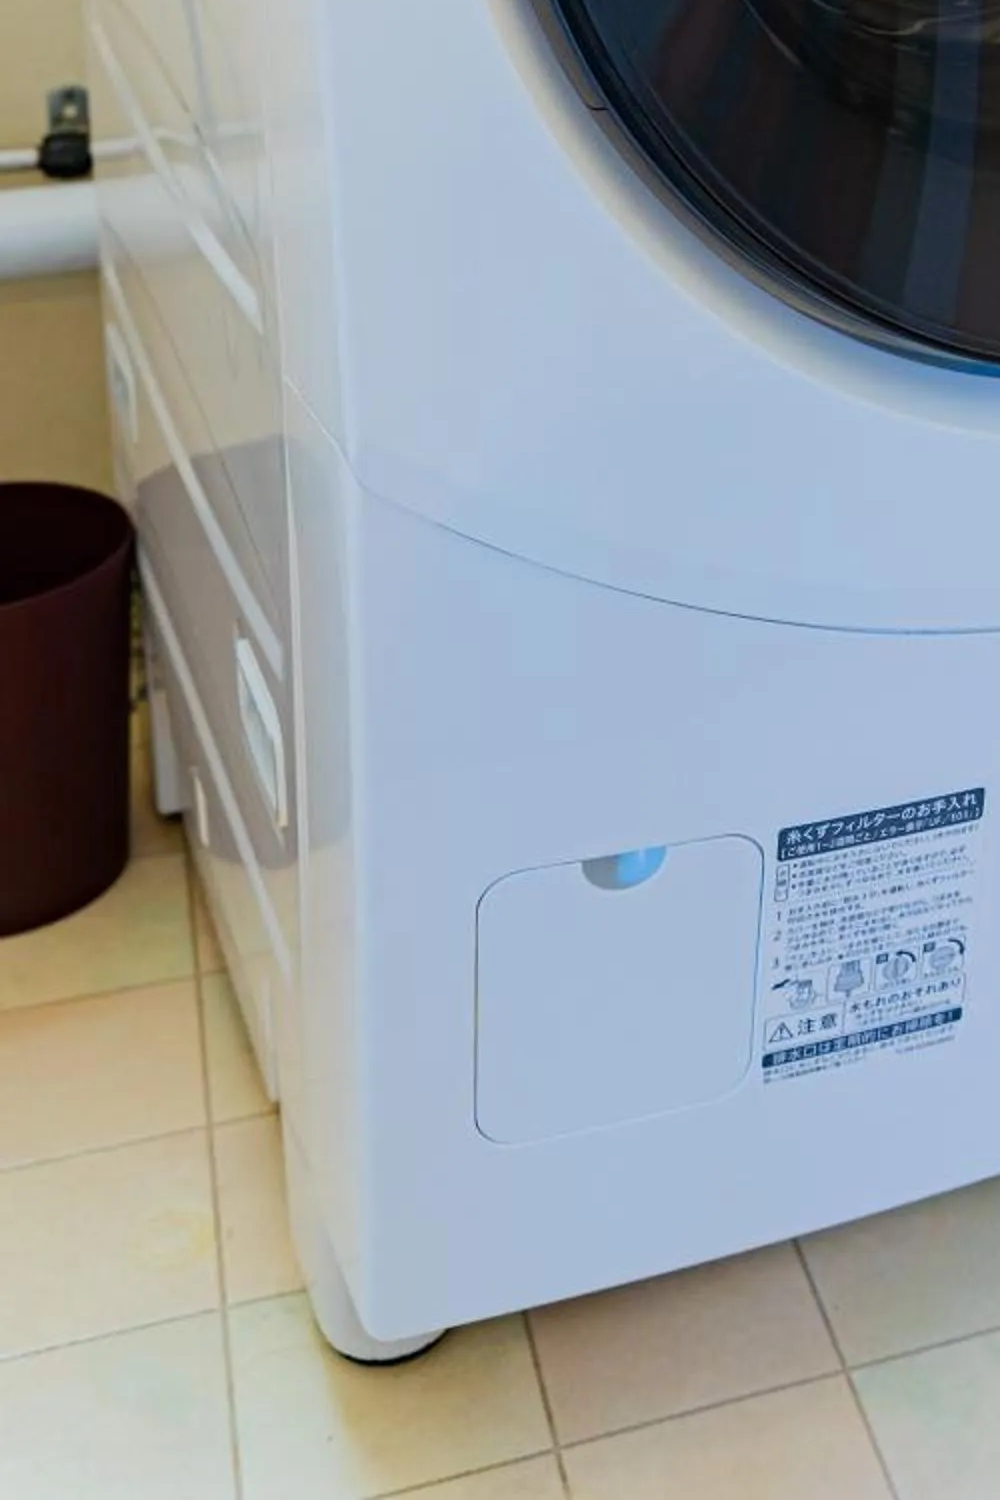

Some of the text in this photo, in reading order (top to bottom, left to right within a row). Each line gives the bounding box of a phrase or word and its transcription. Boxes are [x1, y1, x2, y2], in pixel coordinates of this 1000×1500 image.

[786, 793, 978, 845] 糸くずフィルターのお手入れ
[797, 1012, 838, 1036] 注意
